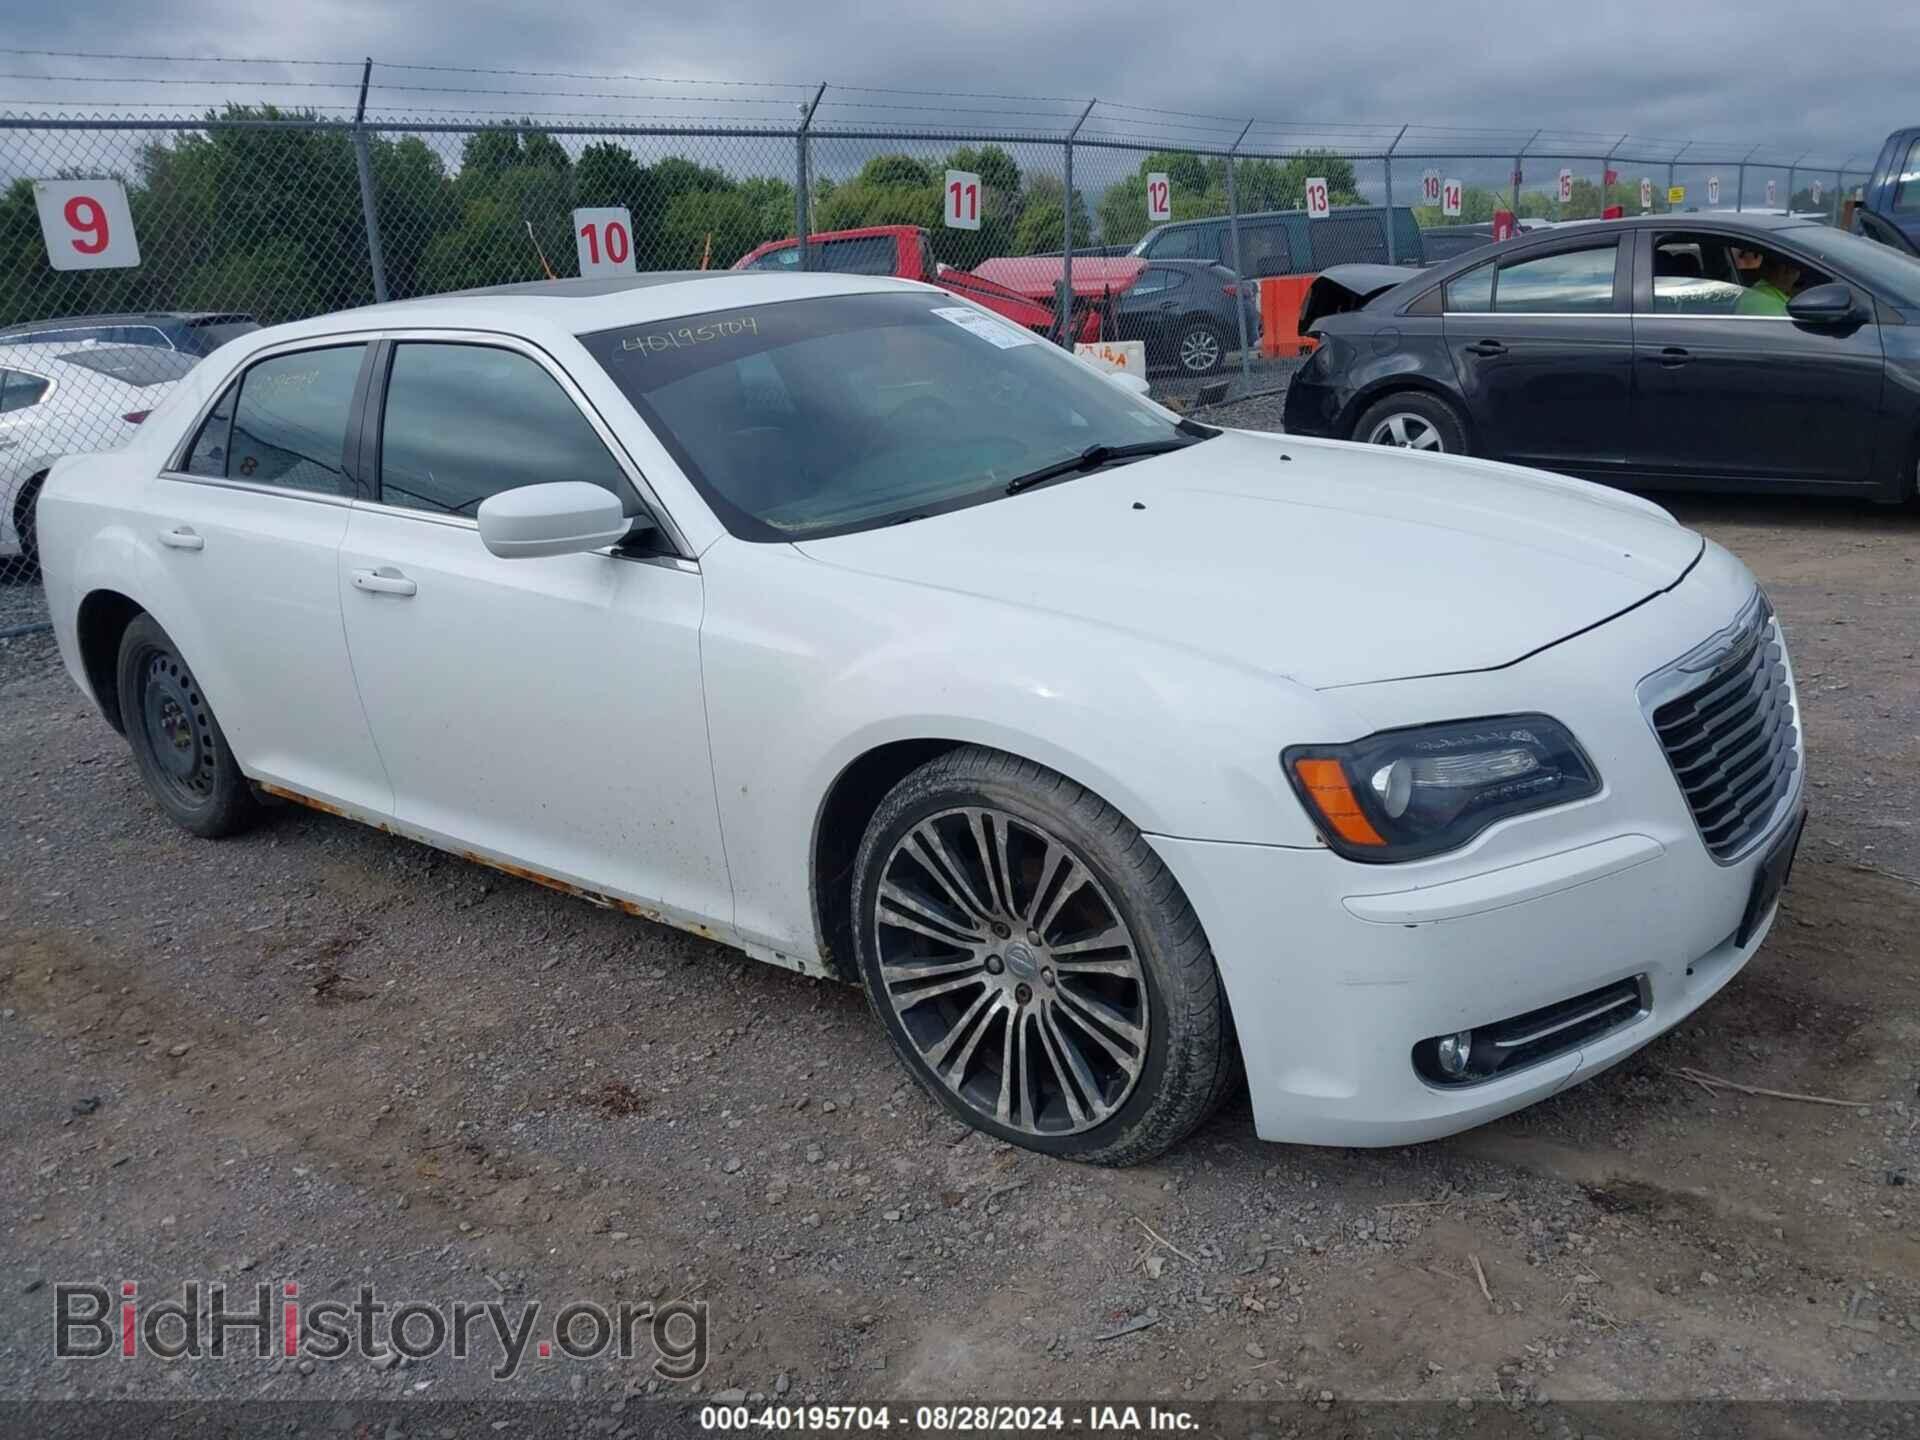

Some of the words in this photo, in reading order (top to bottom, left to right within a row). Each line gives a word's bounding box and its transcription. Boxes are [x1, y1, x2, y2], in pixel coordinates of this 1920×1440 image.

[949, 181, 977, 219] 11
[1149, 182, 1168, 213] 12
[1308, 185, 1326, 212] 13
[1423, 177, 1439, 199] 10
[1445, 186, 1460, 209] 14
[64, 195, 109, 255] 9
[580, 222, 629, 264] 10
[622, 317, 758, 357] 40195704
